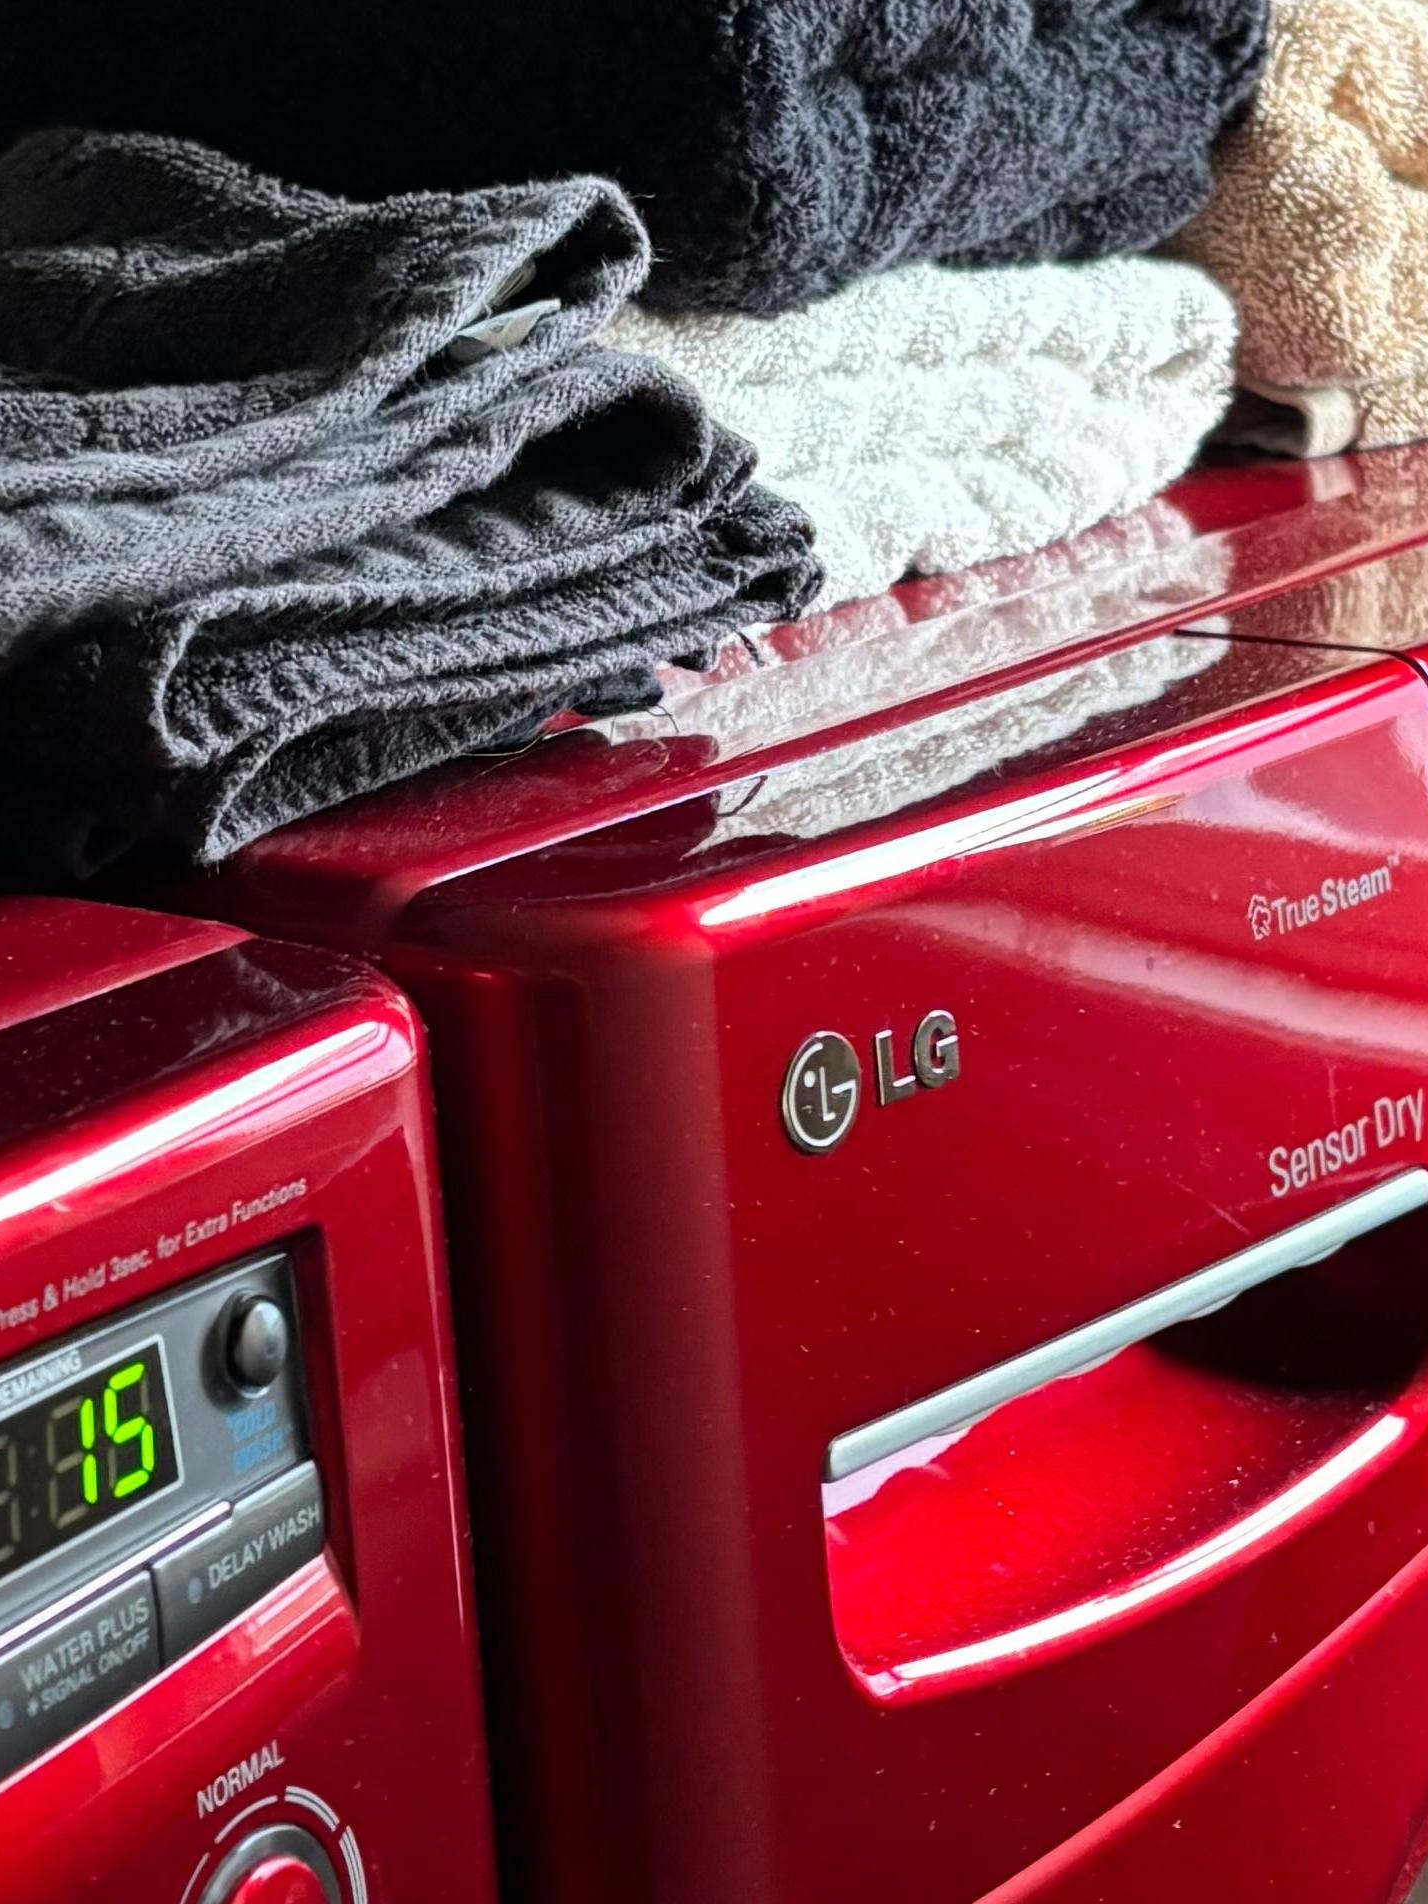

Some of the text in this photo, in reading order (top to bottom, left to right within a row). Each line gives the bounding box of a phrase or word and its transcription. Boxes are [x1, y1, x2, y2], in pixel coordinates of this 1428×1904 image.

[875, 1010, 961, 1107] LG
[1268, 1088, 1426, 1199] Sensor Dry
[44, 1285, 60, 1311] &
[64, 1262, 106, 1302] Hold
[110, 1246, 153, 1287] 3sec.
[157, 1234, 181, 1260] for
[185, 1214, 228, 1250] Extra
[231, 1177, 308, 1230] Functions
[80, 1362, 155, 1505] 15
[209, 1506, 322, 1591] DELAY WASH
[20, 1597, 150, 1691] WATER PLUS
[41, 1628, 152, 1712] SIGNAL ON/OFF
[195, 1739, 286, 1820] NORMAL
